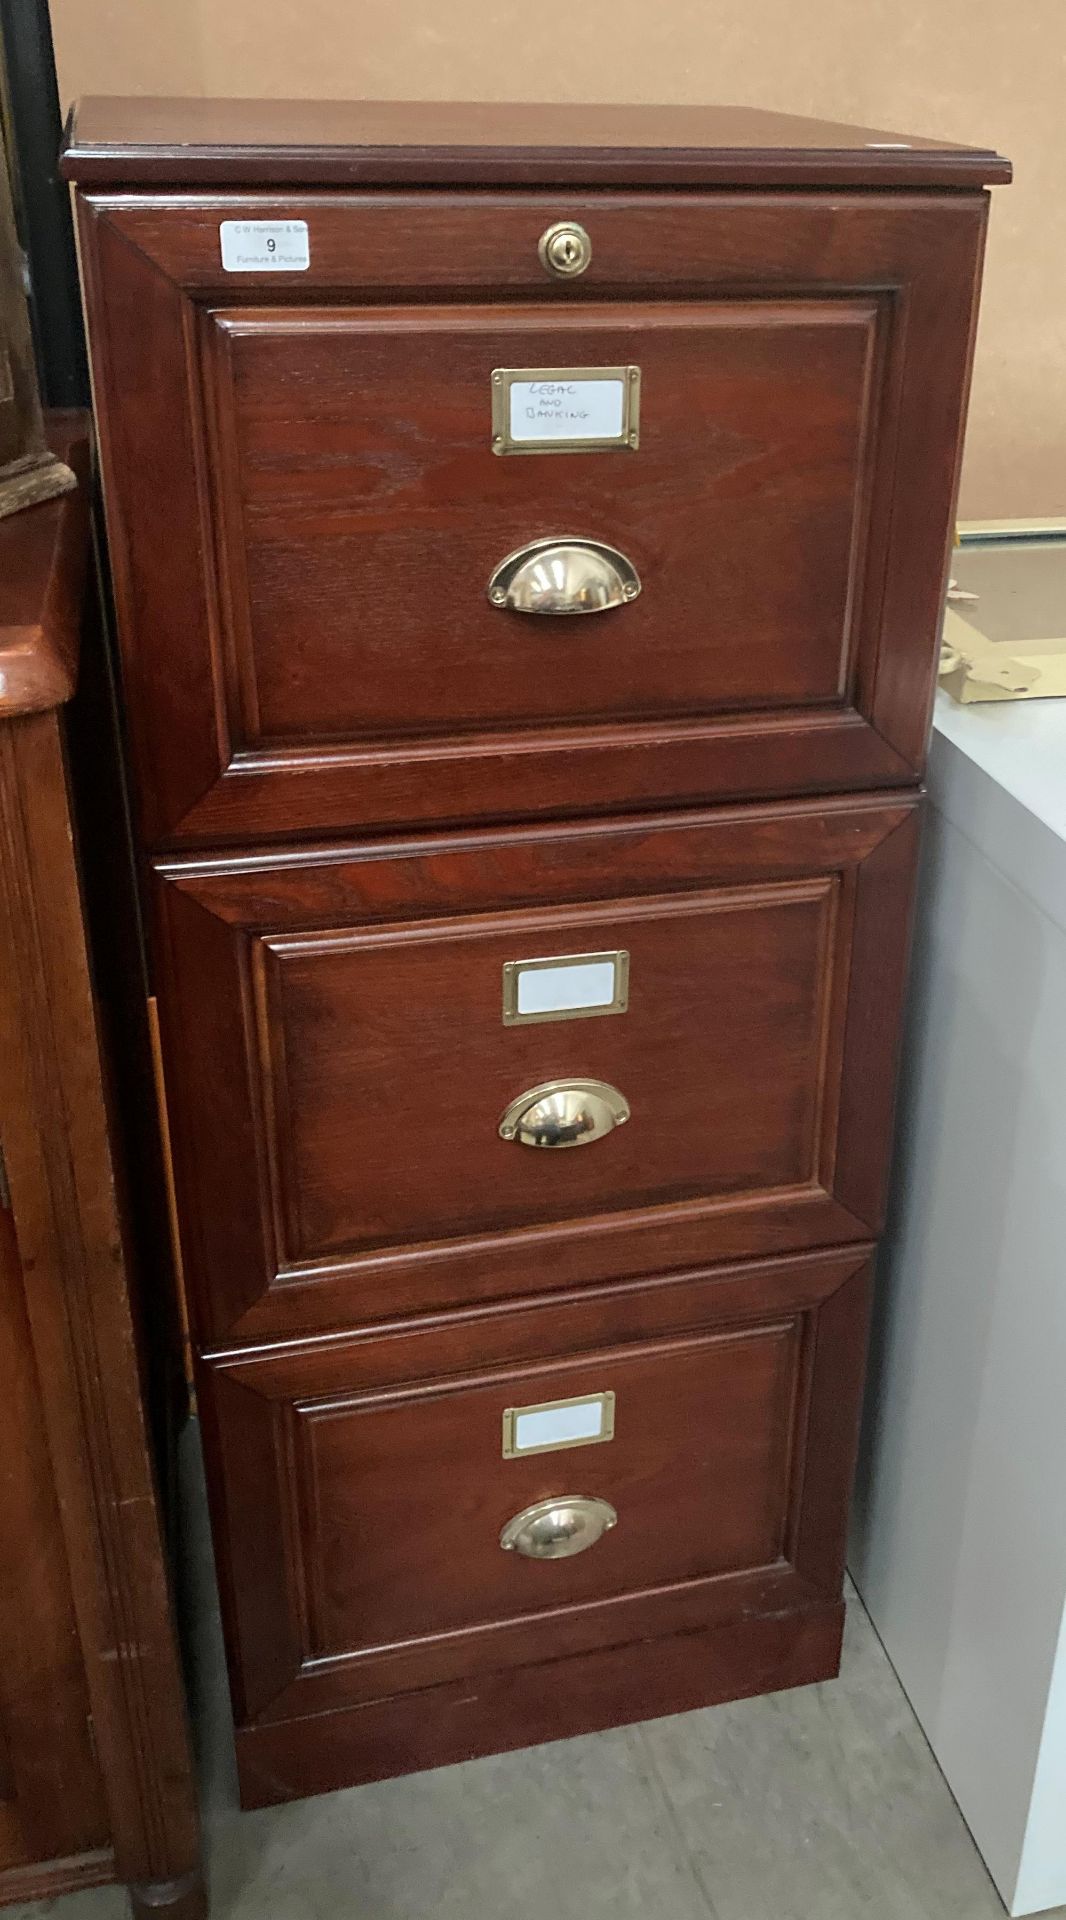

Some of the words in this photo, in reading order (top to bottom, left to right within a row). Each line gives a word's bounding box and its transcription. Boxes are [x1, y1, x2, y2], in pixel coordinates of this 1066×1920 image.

[253, 225, 283, 233] Harrison
[266, 238, 276, 252] 9
[237, 255, 269, 263] Furniture
[279, 255, 307, 263] Pictures
[529, 383, 576, 395] LEGAL
[540, 399, 562, 407] AND
[526, 407, 591, 418] BANKING
